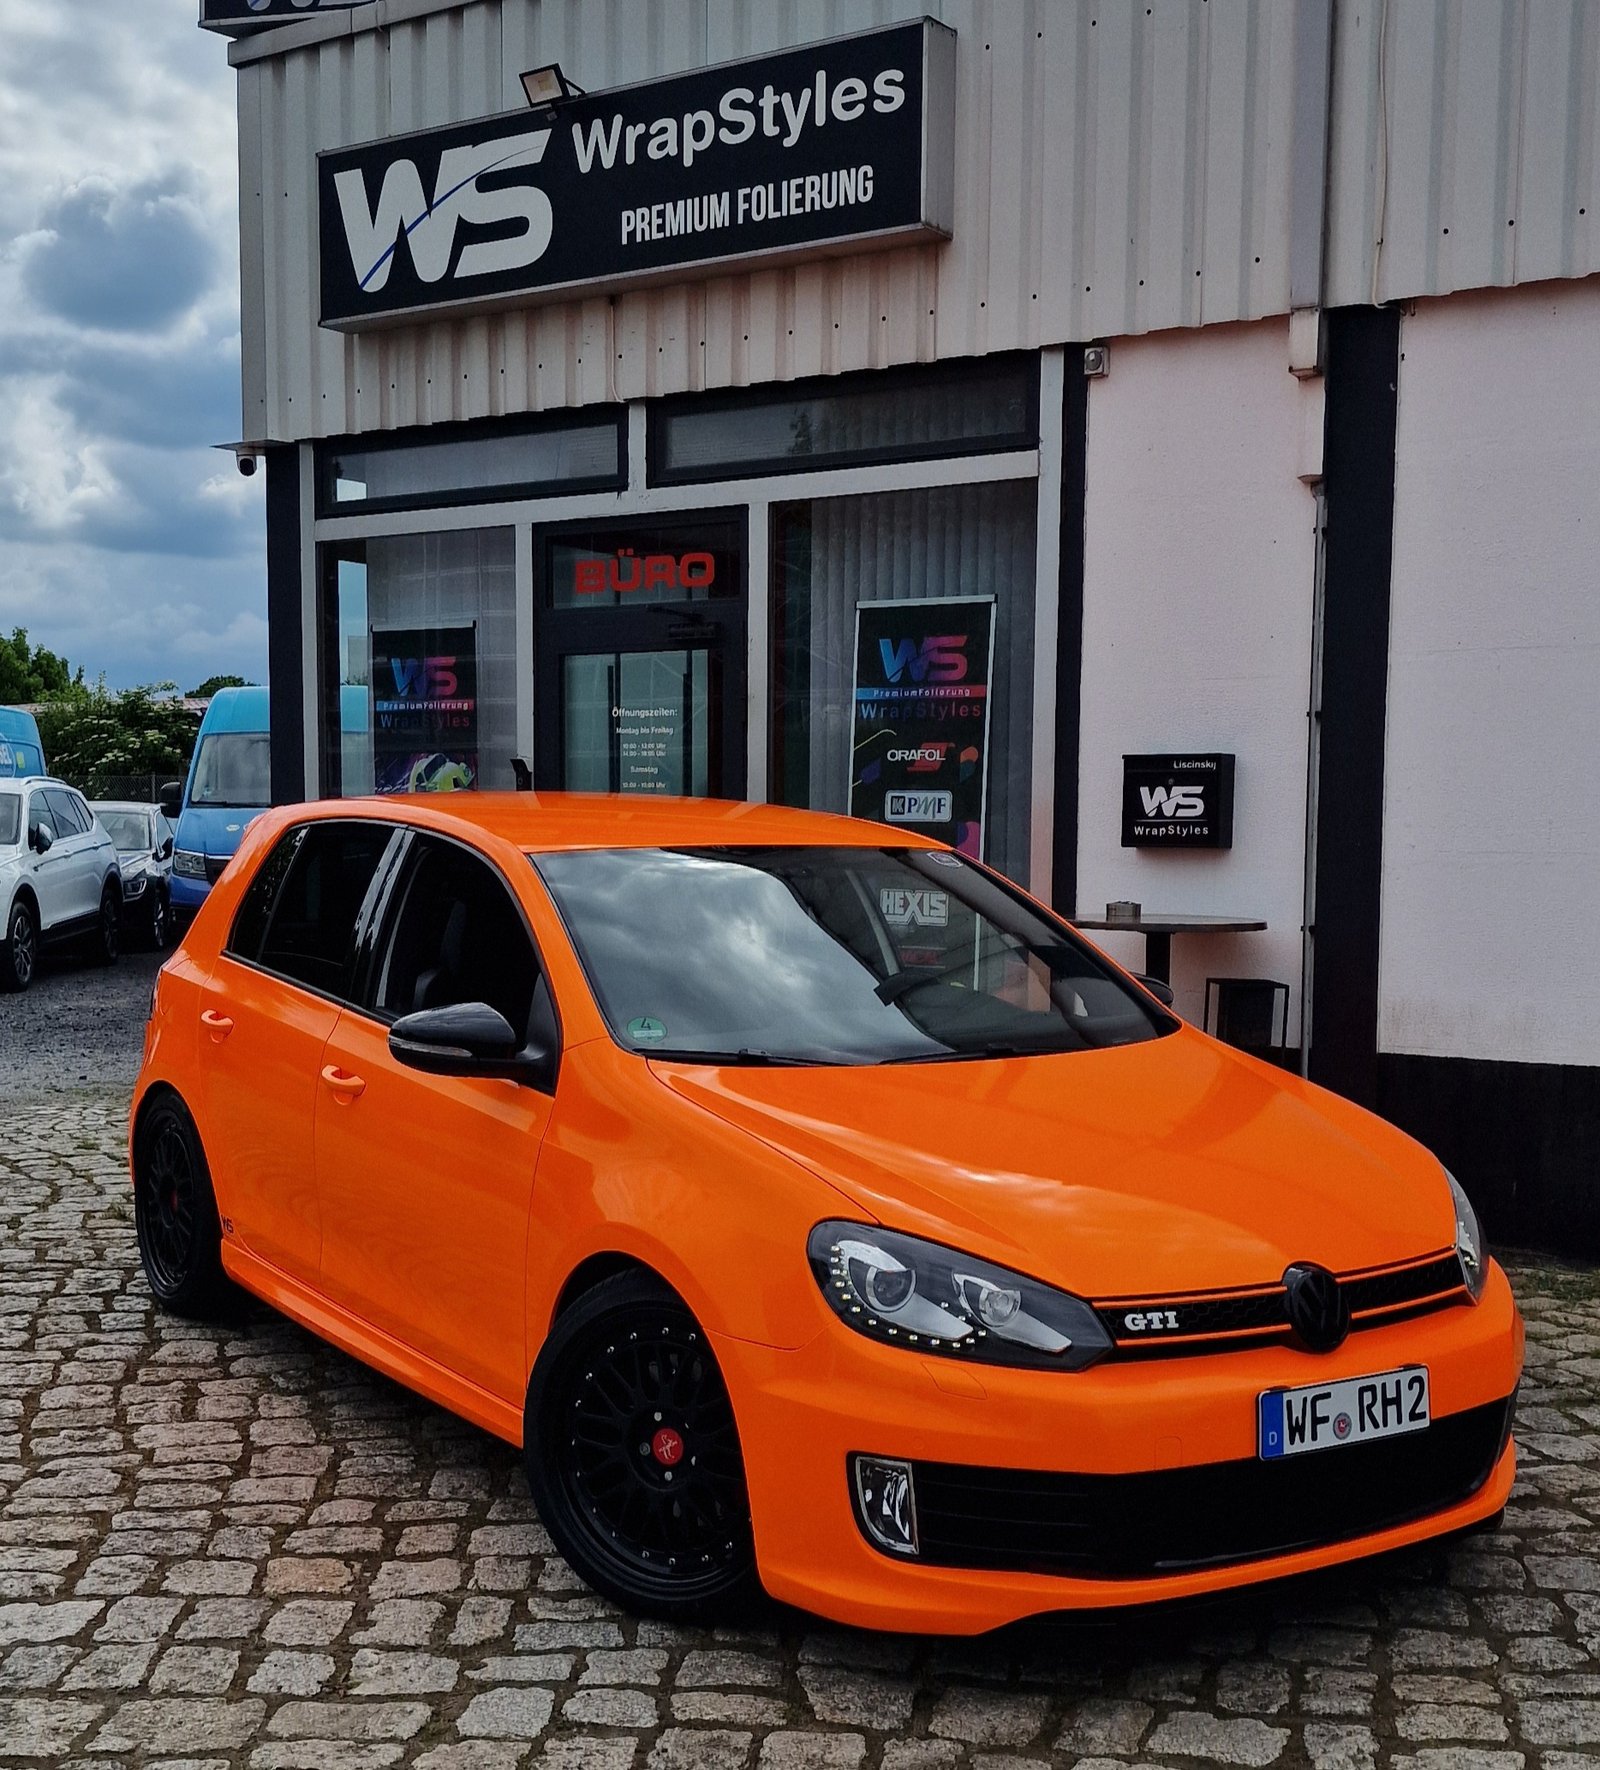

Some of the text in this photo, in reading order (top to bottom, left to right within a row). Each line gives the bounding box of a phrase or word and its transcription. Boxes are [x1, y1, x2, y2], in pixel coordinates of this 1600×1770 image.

[334, 69, 905, 293] WS WrapStyles
[621, 165, 874, 245] PREMIUM FOLIERUNG
[575, 548, 715, 595] BÜRO
[879, 635, 968, 683] WS
[391, 656, 458, 699] WS
[874, 688, 970, 697] PremiumFolierung
[383, 701, 469, 711] PremiumFolierung
[612, 706, 678, 718] Öffnungszeiten:
[861, 701, 981, 720] WrapStyles
[616, 726, 674, 735] Montag bis Freitag
[886, 749, 946, 761] ORAFOL
[1173, 760, 1217, 770] Liscinskij
[630, 765, 658, 774] Samstag
[890, 796, 947, 818] KPMF
[1140, 786, 1204, 817] WS
[1134, 825, 1208, 837] WrapStyles
[881, 890, 947, 924] HEXIS
[1124, 1311, 1180, 1331] GTI
[1269, 1431, 1278, 1446] D
[1286, 1391, 1332, 1445] WF
